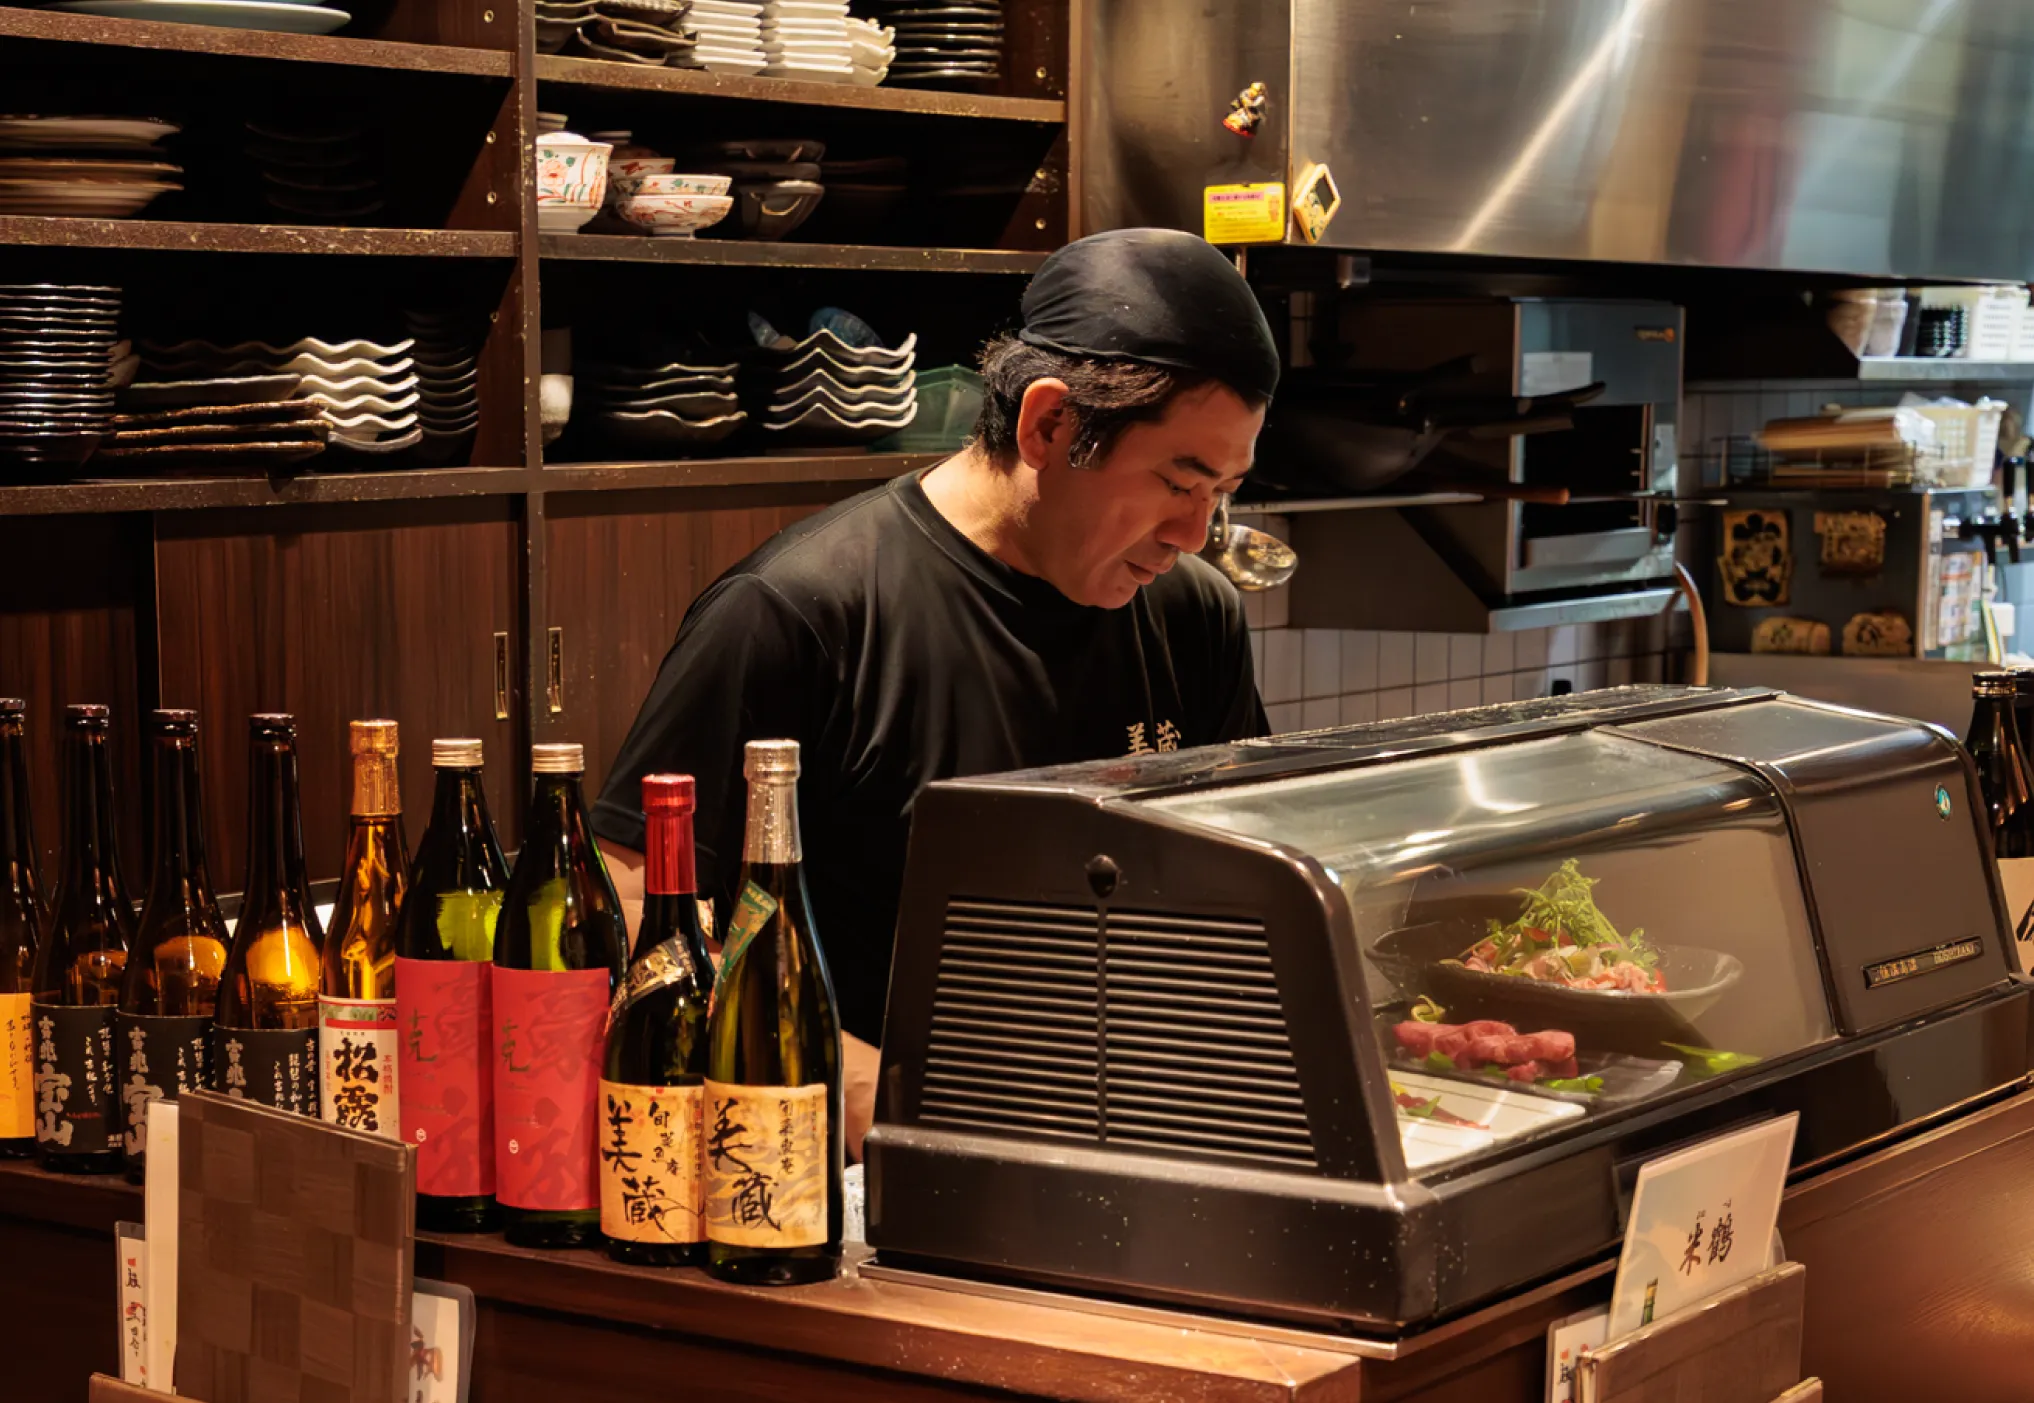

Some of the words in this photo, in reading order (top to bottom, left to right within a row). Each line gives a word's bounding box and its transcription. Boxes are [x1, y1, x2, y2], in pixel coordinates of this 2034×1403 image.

[35, 1015, 74, 1146] 吉兆宝山
[333, 1037, 378, 1131] 松露
